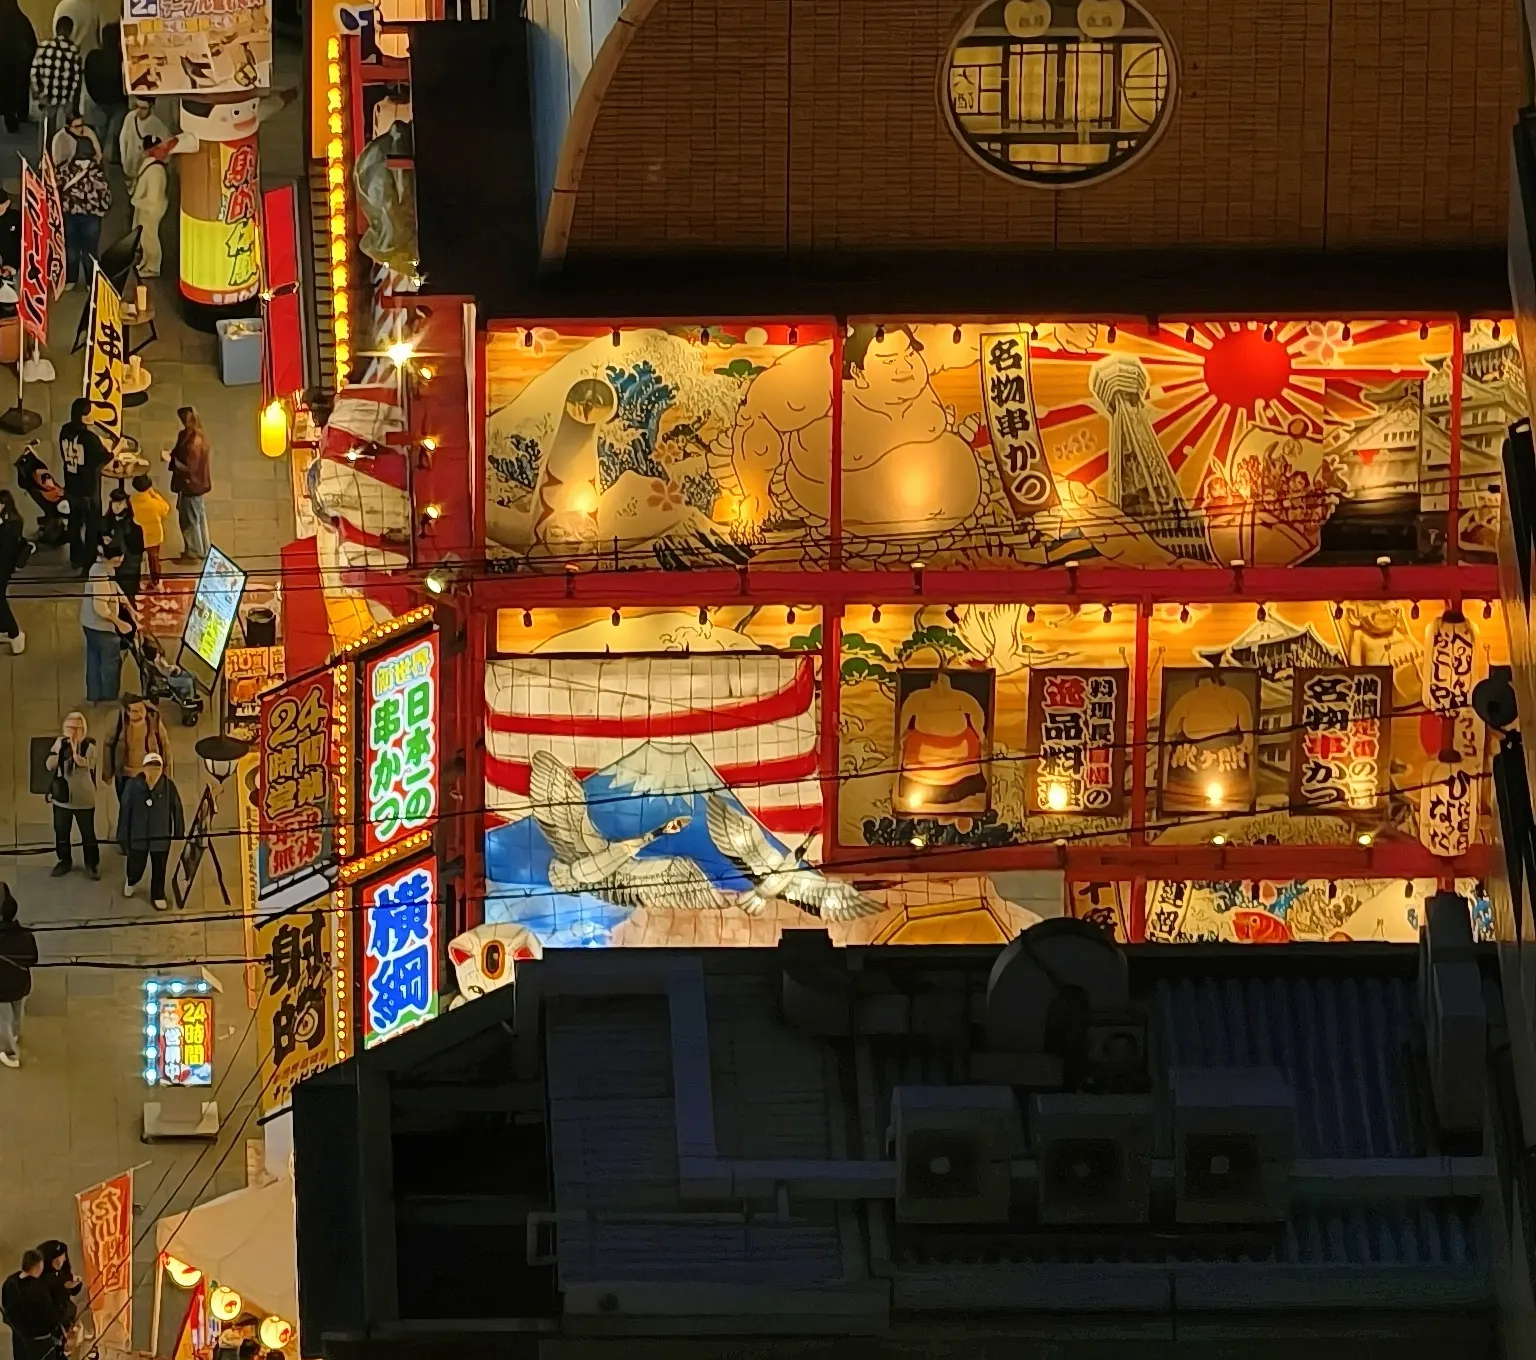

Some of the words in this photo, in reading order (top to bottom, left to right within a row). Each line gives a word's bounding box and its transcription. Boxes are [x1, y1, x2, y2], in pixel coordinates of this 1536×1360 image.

[92, 319, 122, 442] 串かつ
[988, 338, 1048, 504] 名物串かつ
[268, 685, 328, 748] 24
[372, 697, 401, 838] 串かつ
[405, 680, 432, 823] 日本一の
[266, 908, 327, 1068] 射的
[371, 873, 430, 1031] 横綱
